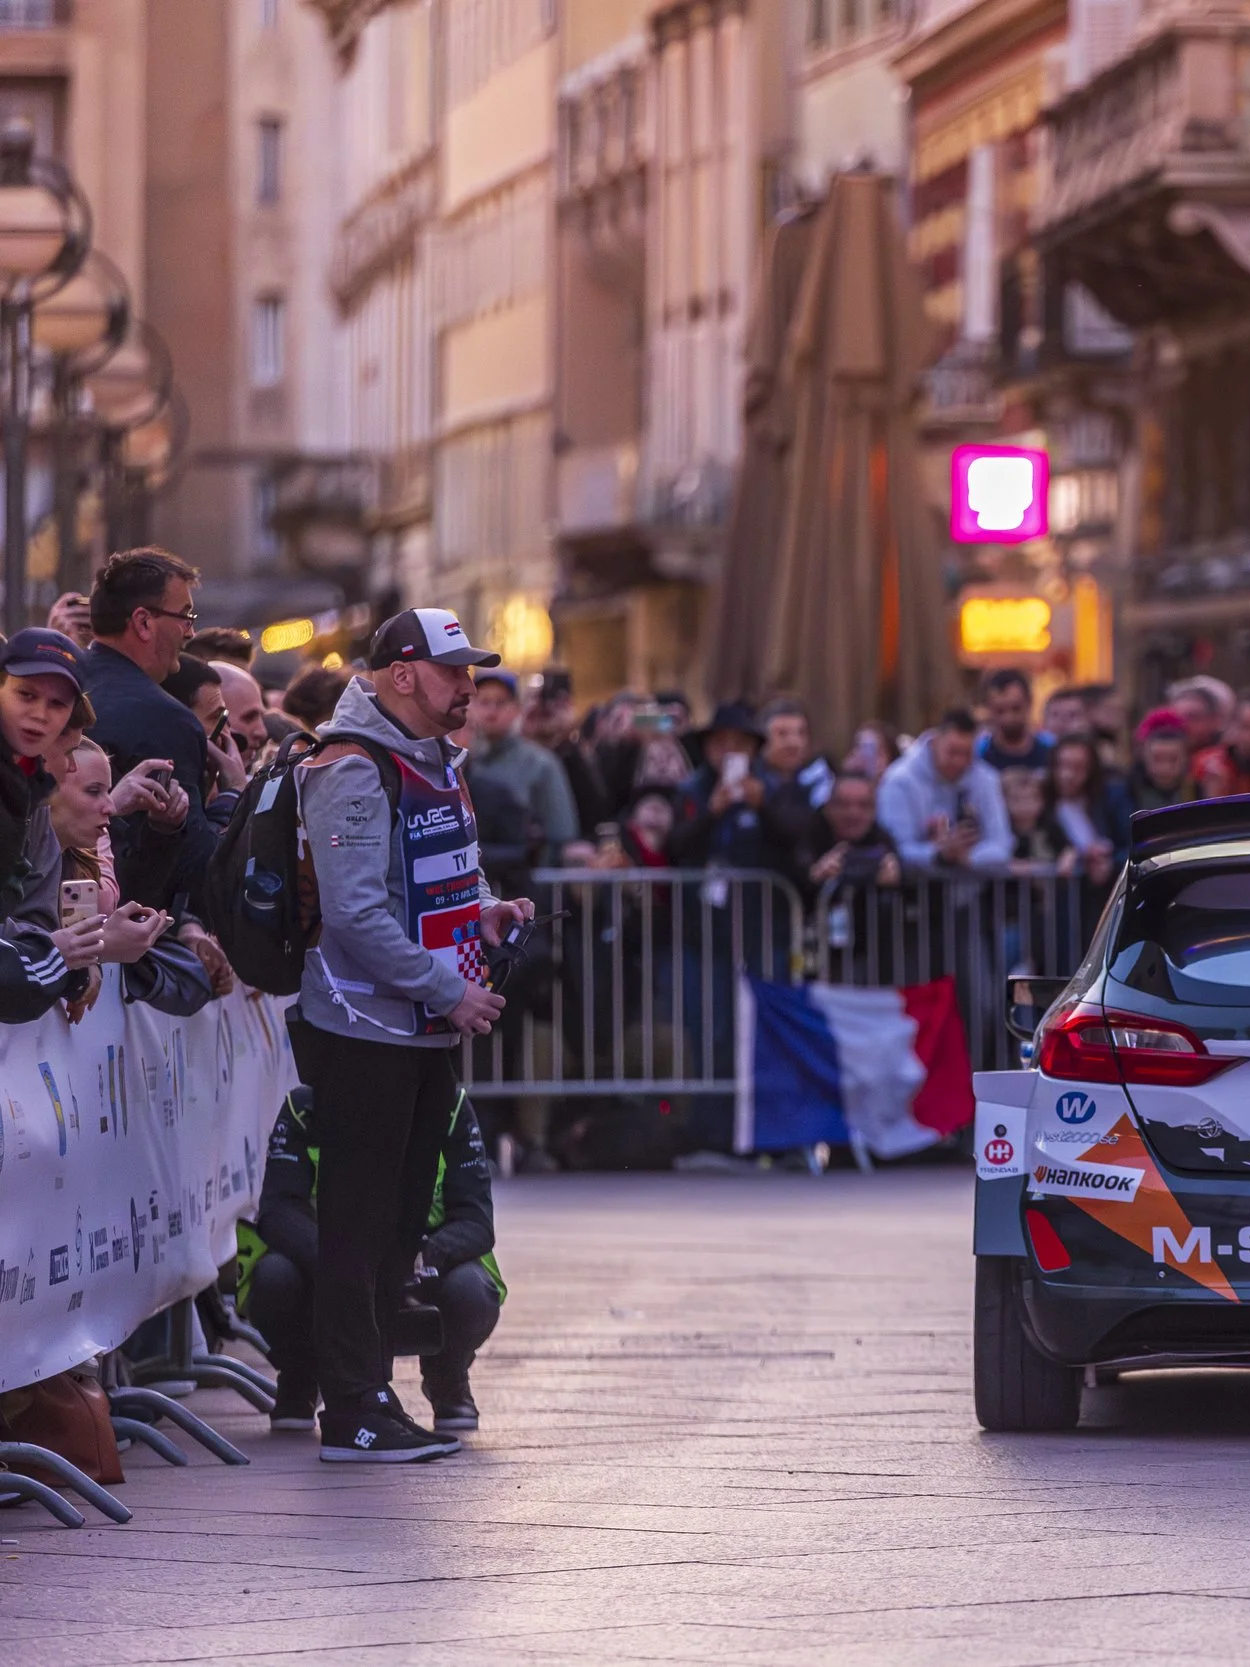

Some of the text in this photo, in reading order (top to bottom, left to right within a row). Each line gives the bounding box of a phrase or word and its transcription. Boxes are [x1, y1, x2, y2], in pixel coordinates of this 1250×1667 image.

[407, 805, 456, 829] WRC
[453, 852, 467, 871] TV
[435, 896, 445, 905] 09
[451, 892, 459, 902] 12
